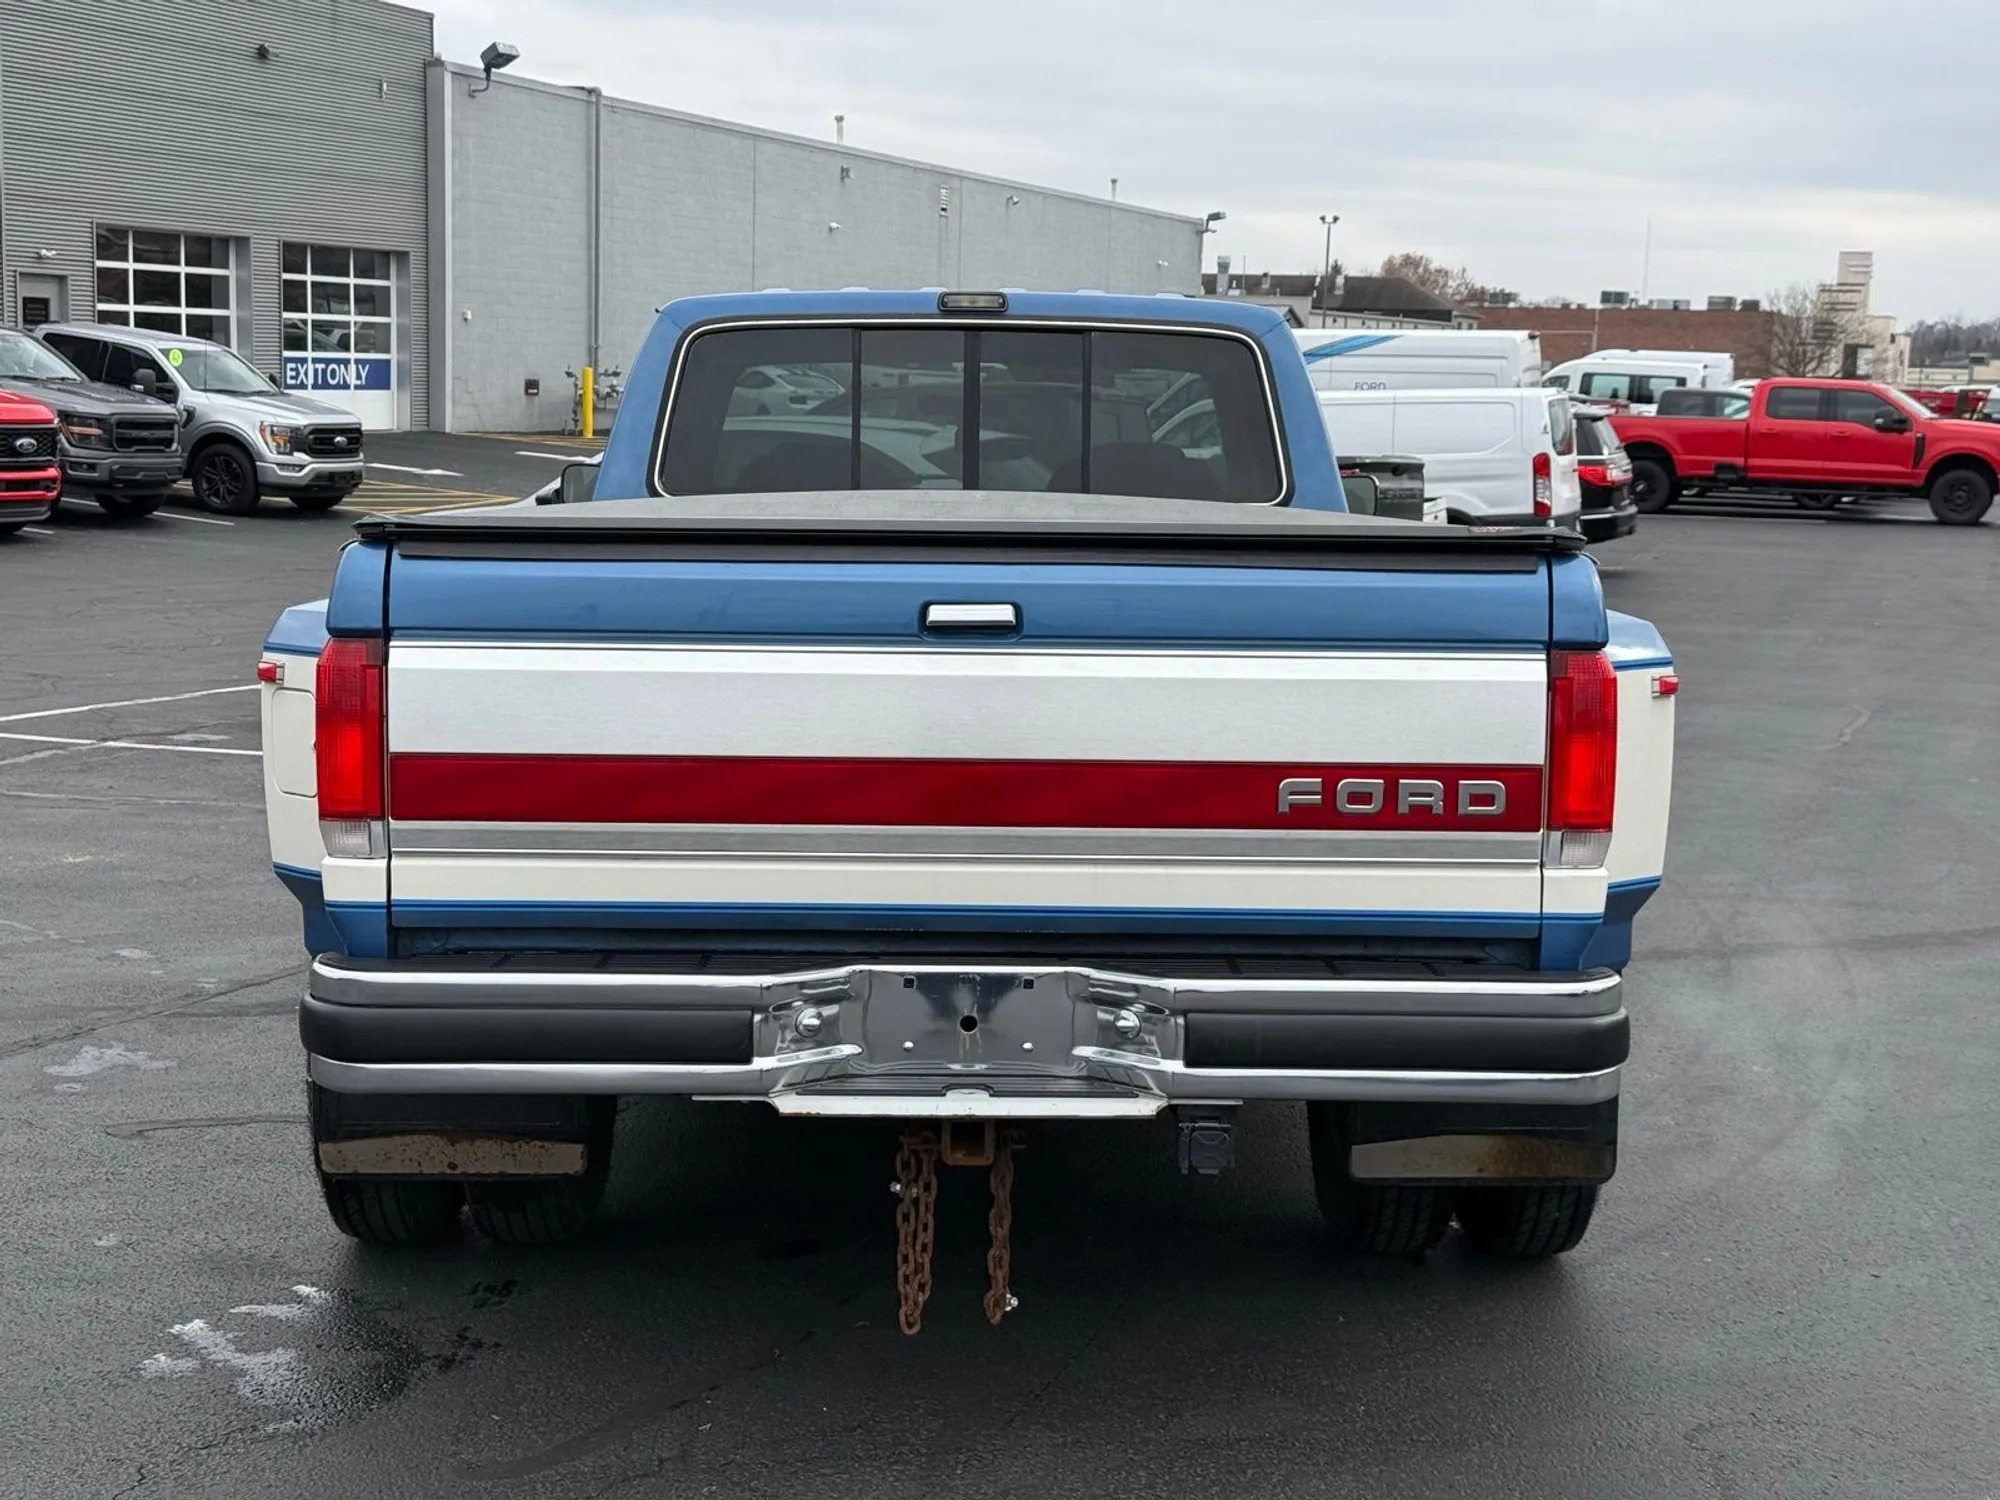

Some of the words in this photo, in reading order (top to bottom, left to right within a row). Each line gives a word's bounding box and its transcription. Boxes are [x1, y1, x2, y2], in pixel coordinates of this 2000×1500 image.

[286, 363, 326, 385] EXIT
[326, 363, 370, 385] ONLY
[1354, 381, 1387, 391] FORD
[1277, 778, 1507, 816] FORD
